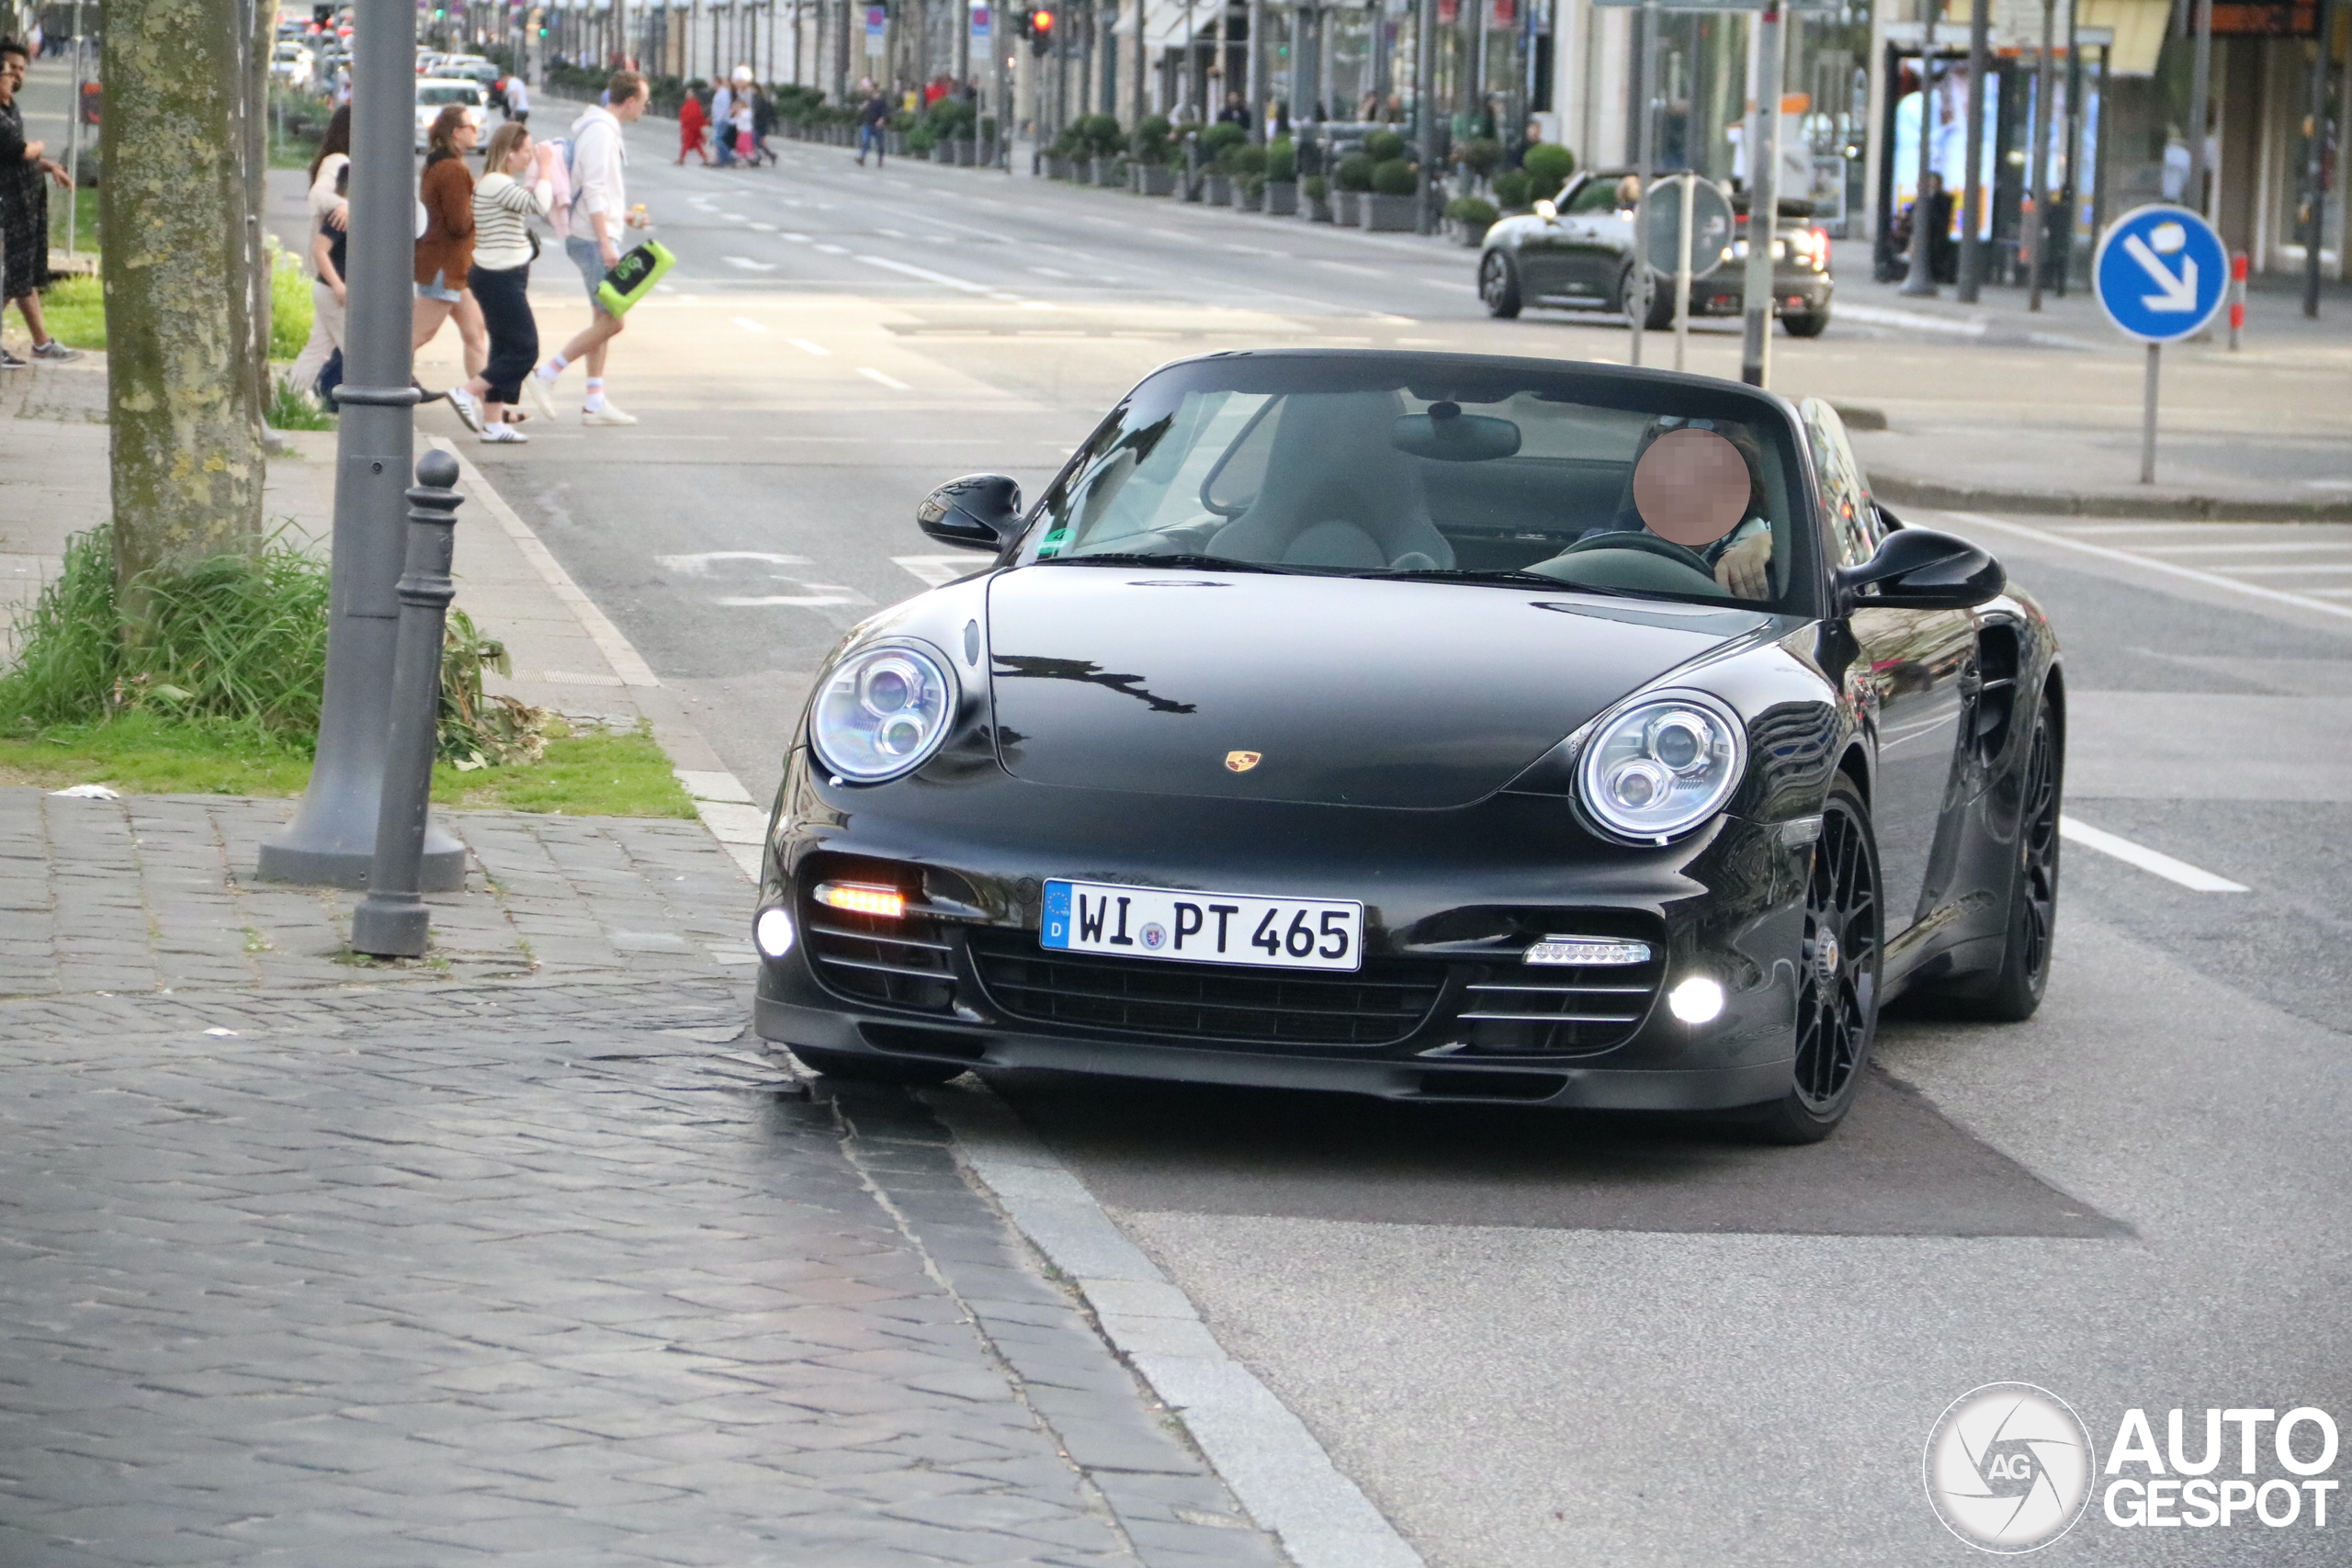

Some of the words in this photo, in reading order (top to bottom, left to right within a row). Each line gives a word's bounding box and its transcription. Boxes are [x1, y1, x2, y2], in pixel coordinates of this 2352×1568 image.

[1053, 529, 1066, 540] 4
[1051, 922, 1062, 937] D
[1079, 893, 1134, 946] WI
[1173, 901, 1238, 953] PT
[1251, 907, 1351, 960] 465
